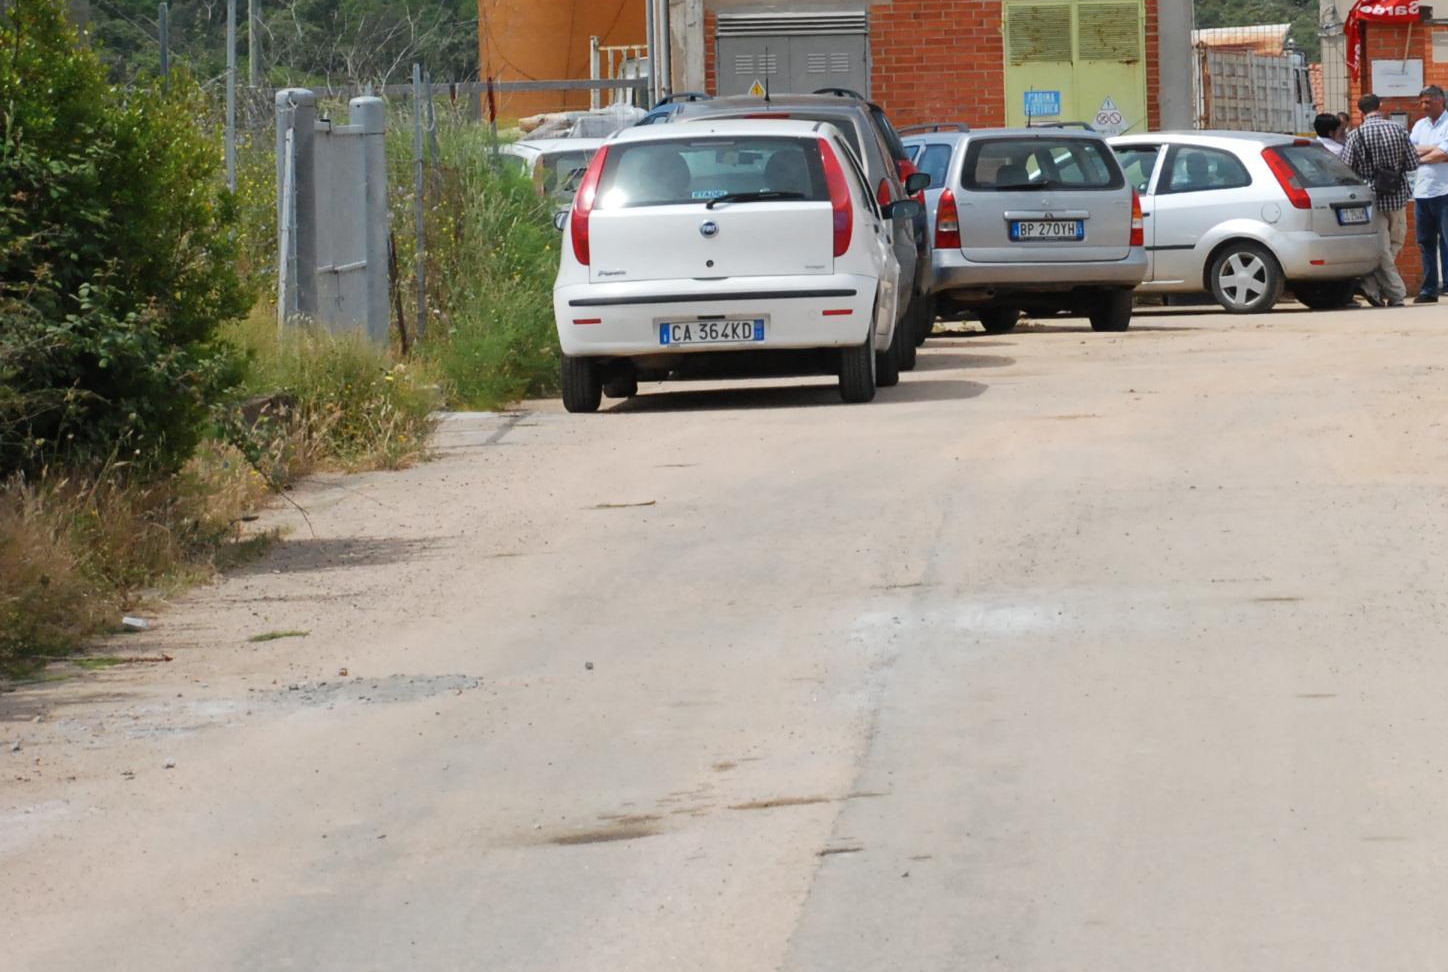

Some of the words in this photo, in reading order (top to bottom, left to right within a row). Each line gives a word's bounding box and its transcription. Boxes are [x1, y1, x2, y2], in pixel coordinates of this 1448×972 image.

[1020, 223, 1034, 236] BP
[1039, 223, 1075, 236] 270YH
[672, 324, 692, 342] CA
[699, 322, 752, 340] 364KD
